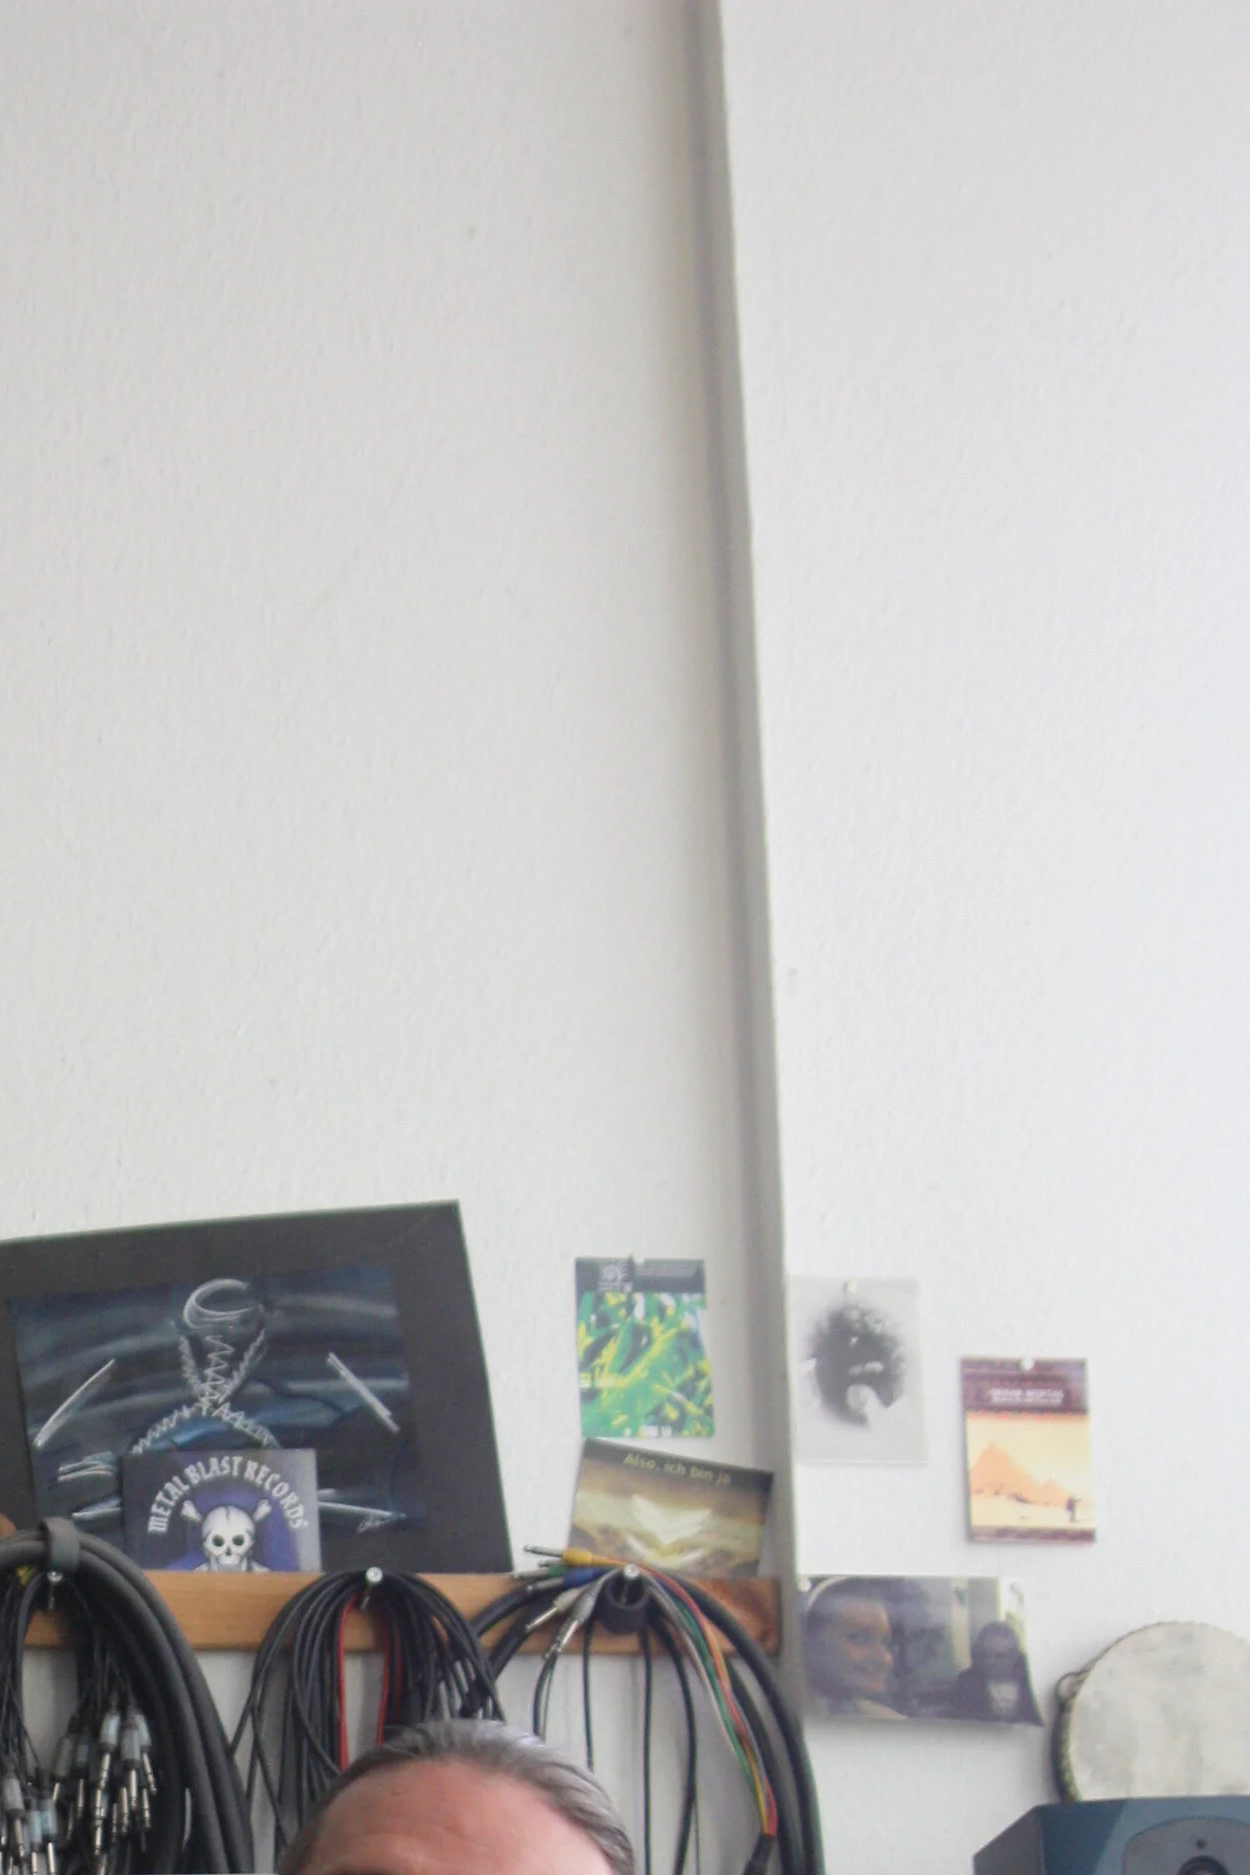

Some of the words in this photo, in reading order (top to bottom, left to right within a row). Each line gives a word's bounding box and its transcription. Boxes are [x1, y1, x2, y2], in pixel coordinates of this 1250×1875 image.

[147, 1475, 190, 1534] METAL
[184, 1456, 244, 1485] BLAST
[243, 1459, 309, 1529] RECORDS
